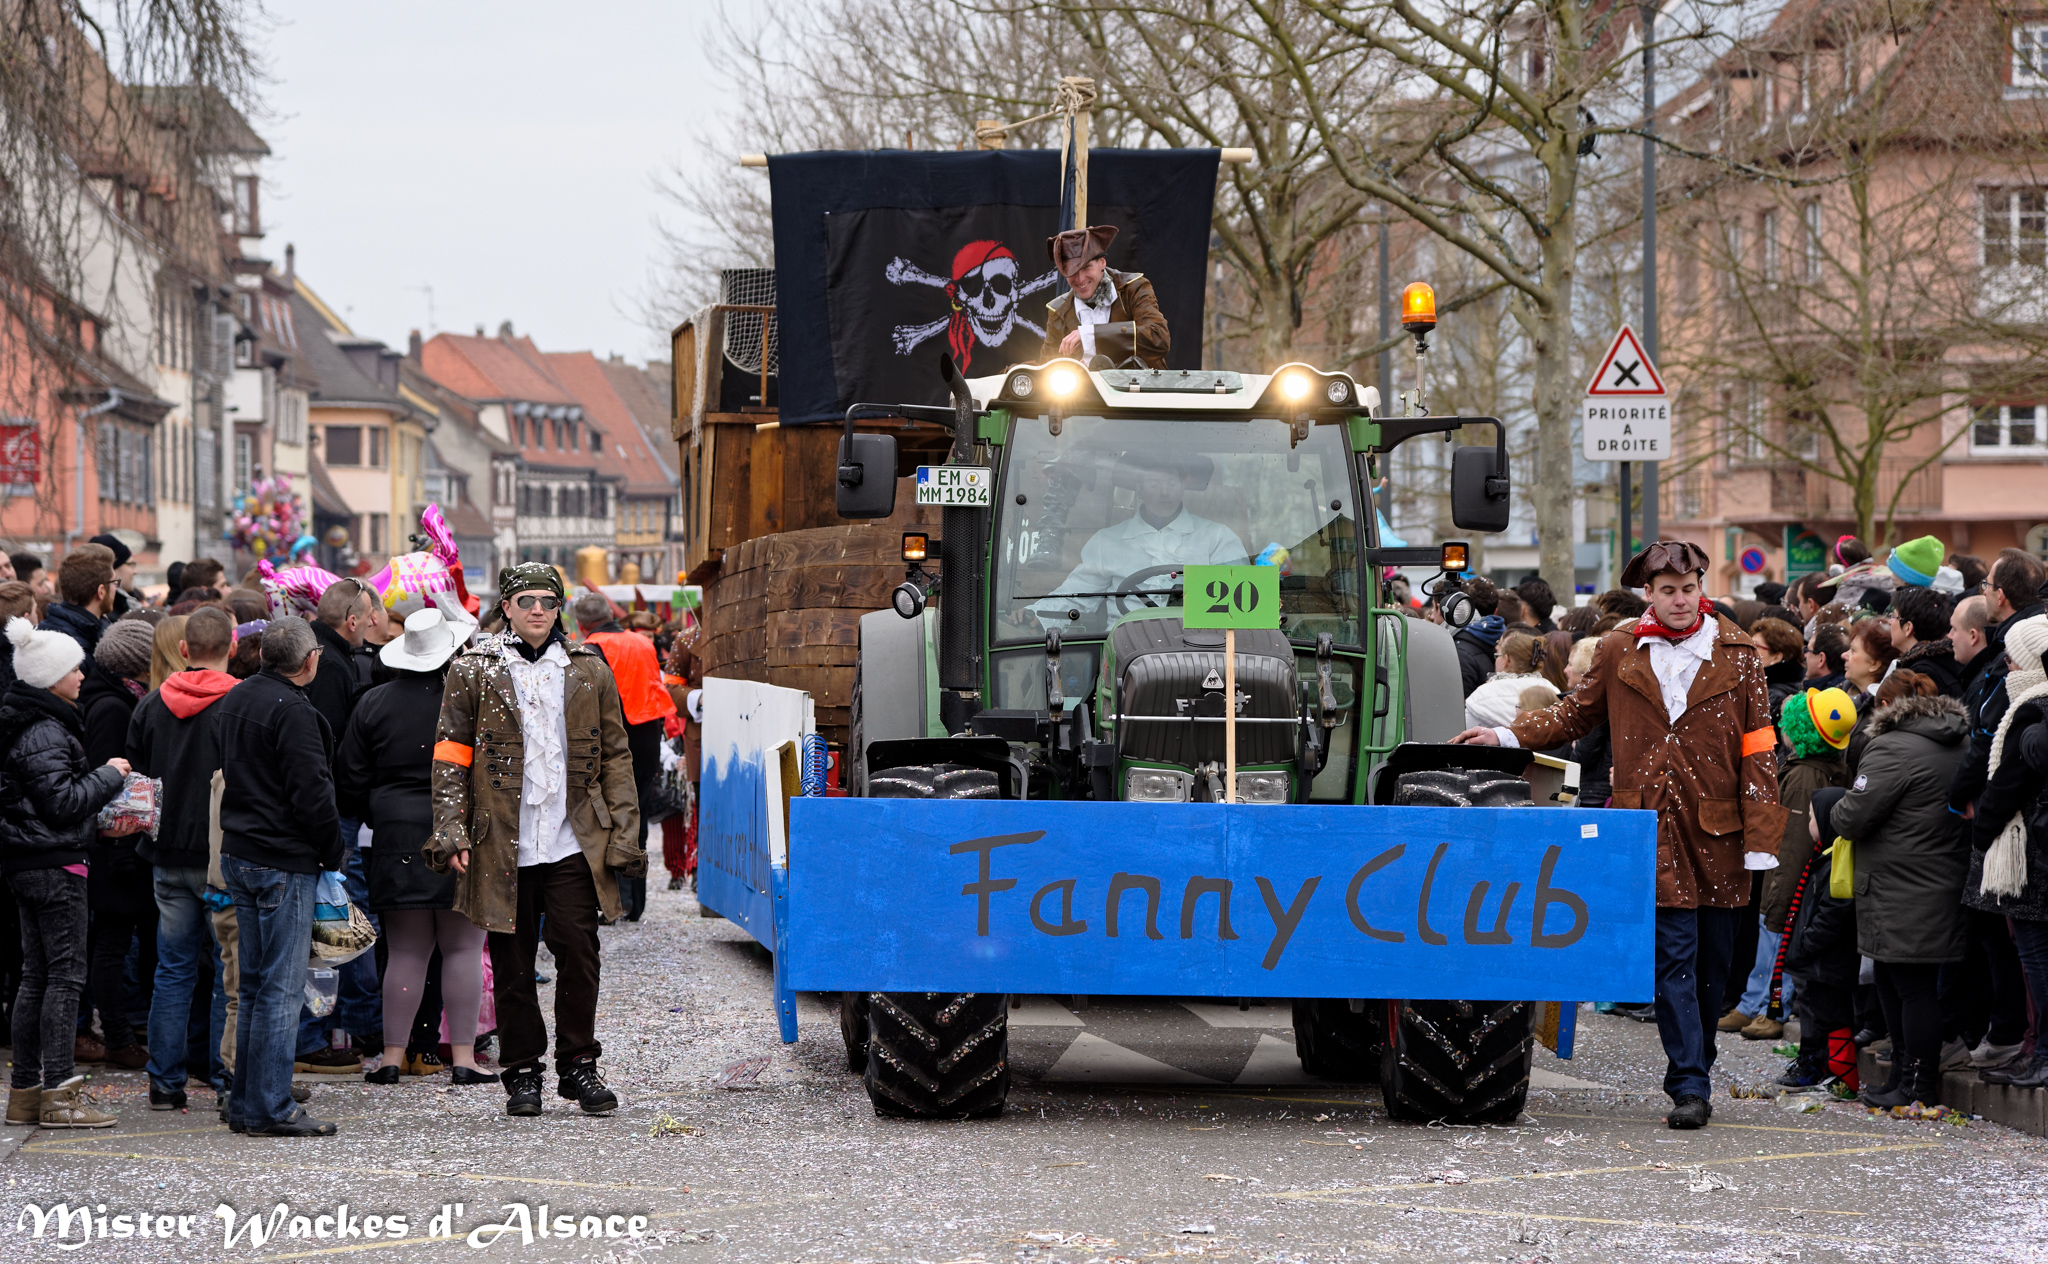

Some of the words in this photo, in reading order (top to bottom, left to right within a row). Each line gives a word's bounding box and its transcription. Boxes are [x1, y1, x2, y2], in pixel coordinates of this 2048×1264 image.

[1588, 405, 1667, 420] PRIORITÉ
[1623, 423, 1633, 435] A
[1598, 439, 1658, 451] DROITE
[938, 469, 961, 486] EM
[919, 486, 942, 503] MM
[945, 487, 988, 504] 1984
[1205, 580, 1260, 614] 20
[950, 831, 1323, 971] Fanny
[1345, 843, 1590, 949] Club
